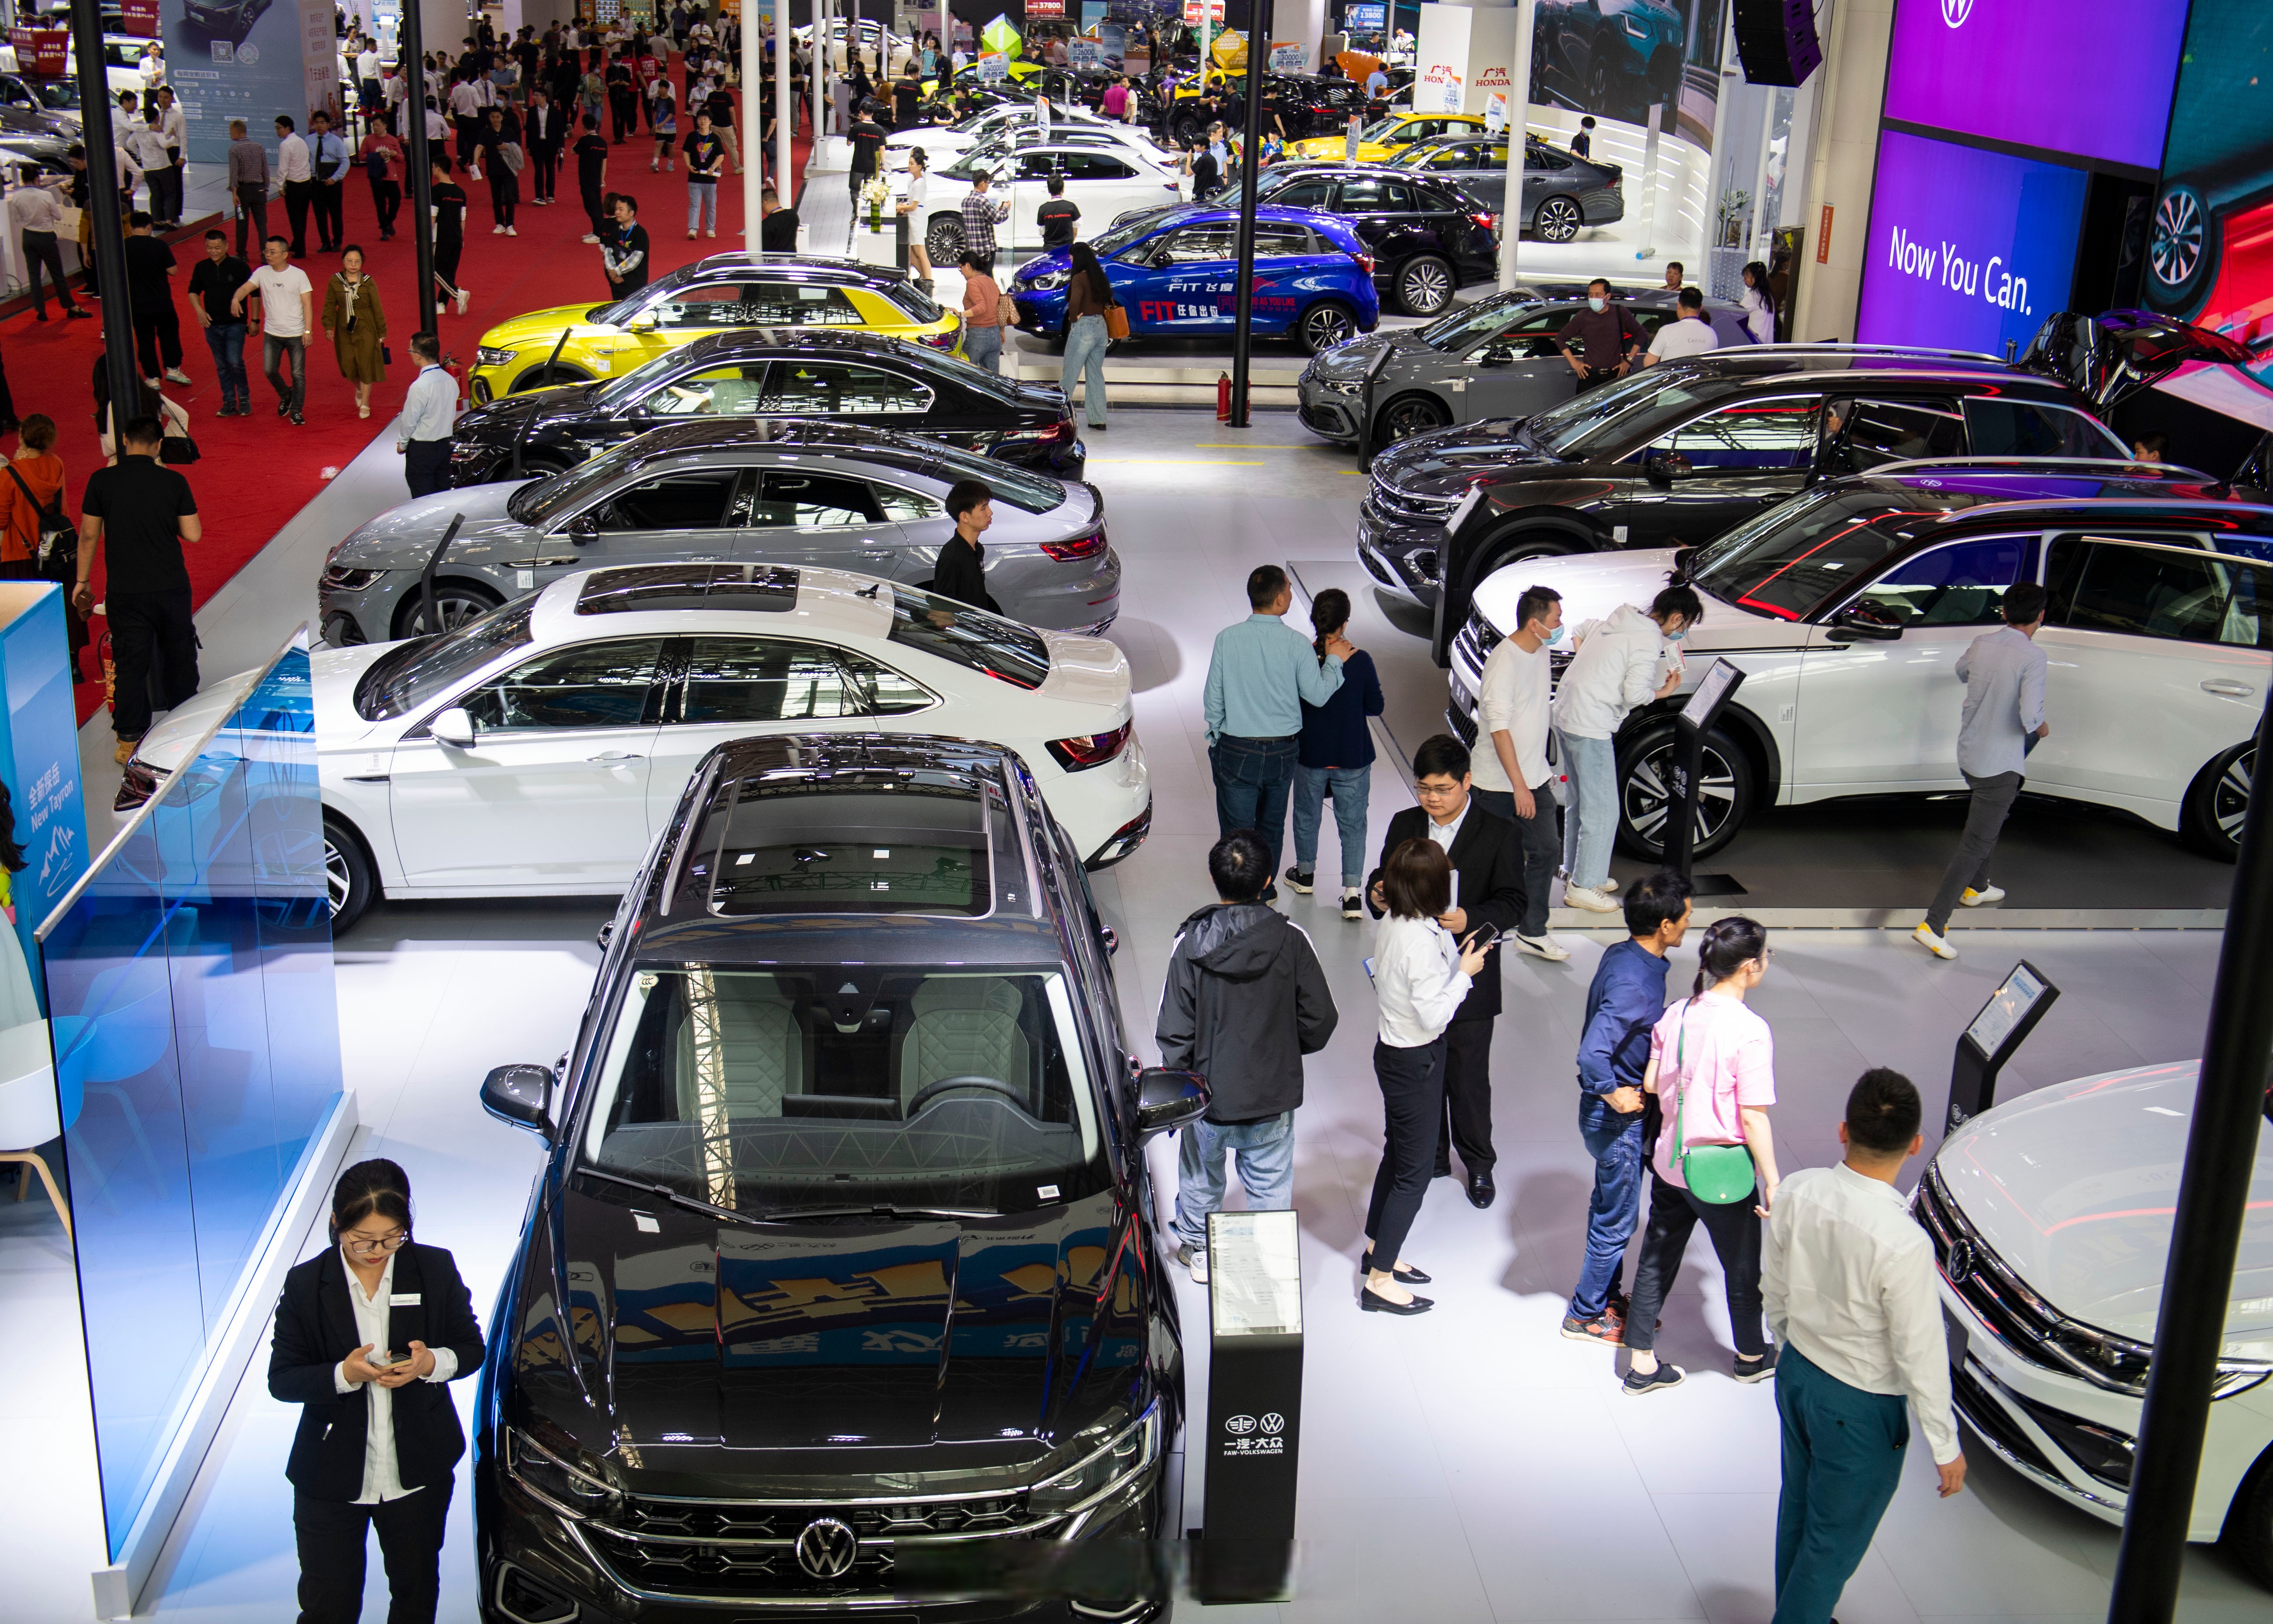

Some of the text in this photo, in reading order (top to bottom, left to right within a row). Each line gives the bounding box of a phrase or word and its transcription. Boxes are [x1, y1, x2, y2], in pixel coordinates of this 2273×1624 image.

[1430, 65, 1452, 75] 广汽
[1483, 68, 1507, 77] 广汽
[1889, 225, 1937, 280] Now
[1942, 241, 1979, 296] You
[1984, 256, 2031, 316] Can.
[1168, 283, 1234, 292] FIT 飞度
[1259, 297, 1268, 305] AS
[1269, 297, 1281, 306] YOU
[1282, 298, 1296, 306] LIKE
[1140, 301, 1219, 321] FIT 任你出位
[28, 761, 60, 810] 全新探岳
[31, 780, 73, 833] New Tayron
[1224, 1437, 1283, 1449] 一汽-大众
